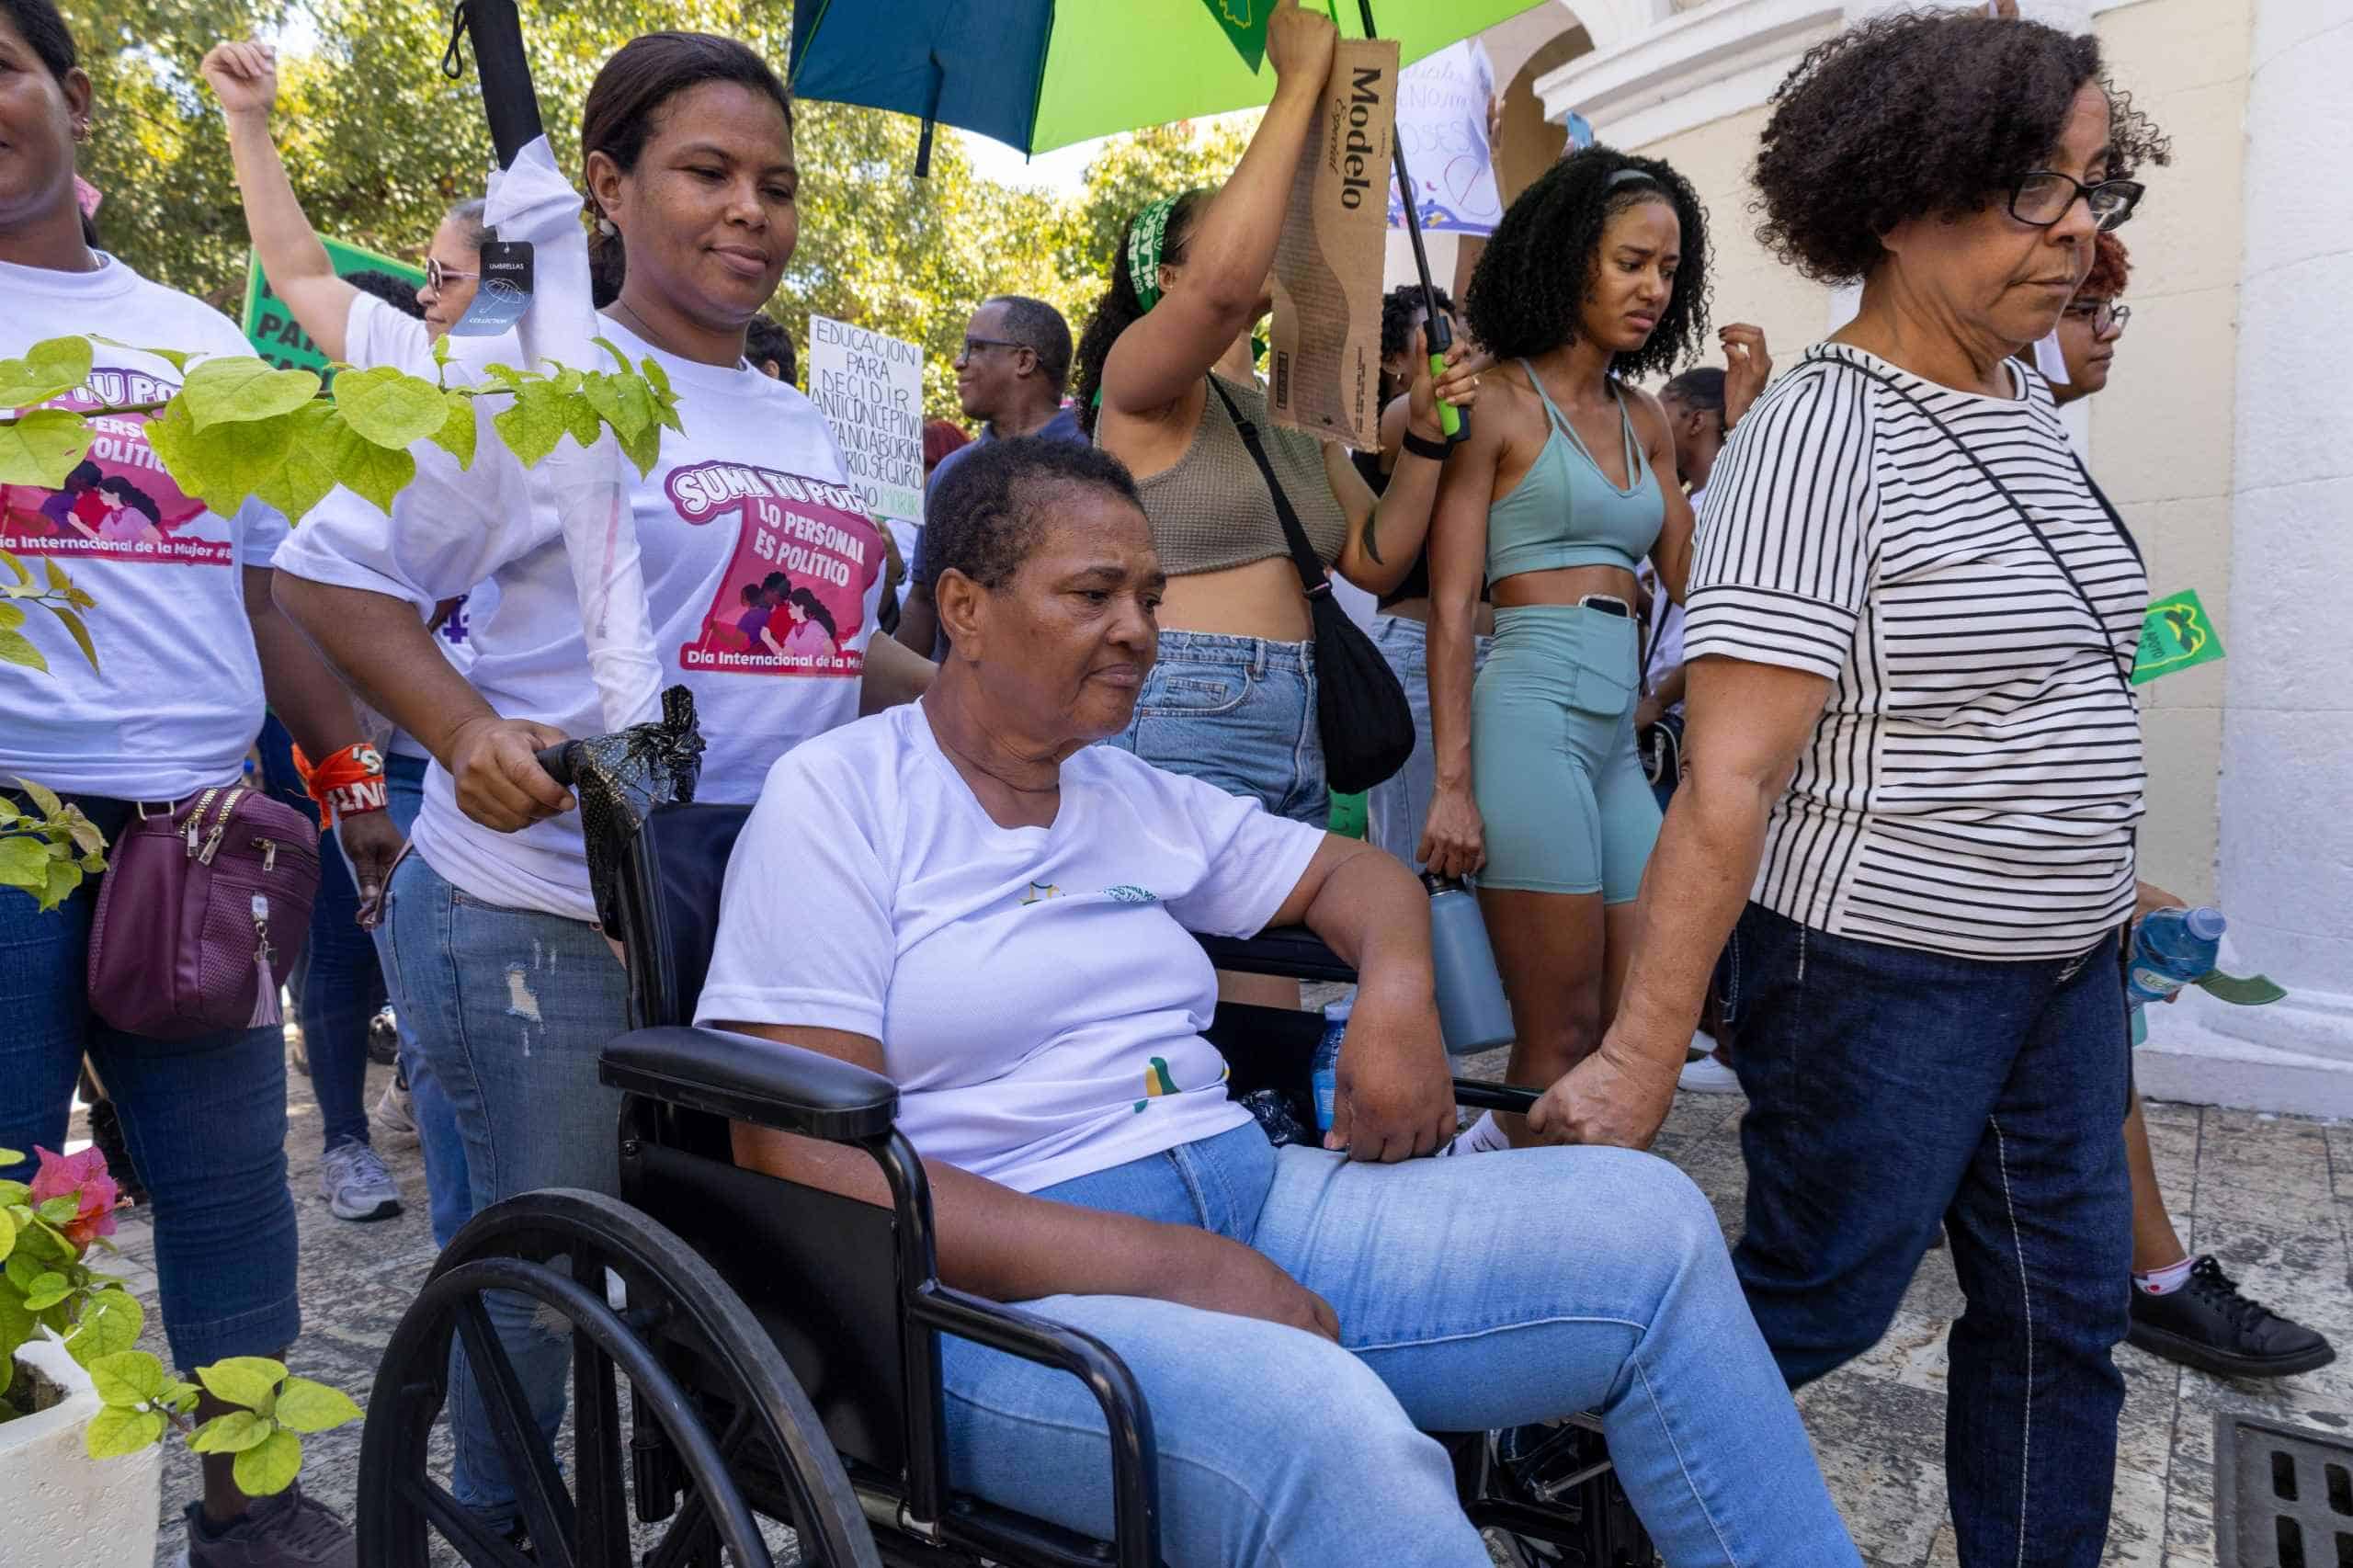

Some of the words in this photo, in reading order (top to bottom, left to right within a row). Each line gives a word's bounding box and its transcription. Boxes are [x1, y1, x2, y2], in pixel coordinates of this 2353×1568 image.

[1329, 97, 1347, 176] Especial
[1341, 66, 1381, 210] Modelo
[489, 262, 525, 271] UMBRELLAS
[816, 319, 915, 367] EDUCACION
[822, 368, 909, 413] DECIDIR
[846, 351, 891, 384] PARA
[672, 465, 772, 515] SUMA
[759, 472, 811, 503] TU
[868, 454, 923, 491] SEGURO
[21, 536, 133, 552] Internacional
[134, 540, 154, 554] de
[157, 541, 172, 554] la
[174, 542, 214, 560] Mujer
[758, 498, 781, 528] LO
[784, 511, 865, 566] PERSONAL
[753, 527, 777, 561] ES
[776, 541, 850, 587] POLÍTICO
[687, 651, 715, 665] Día
[718, 651, 813, 666] Internacional
[815, 655, 830, 667] de
[831, 656, 844, 668] la
